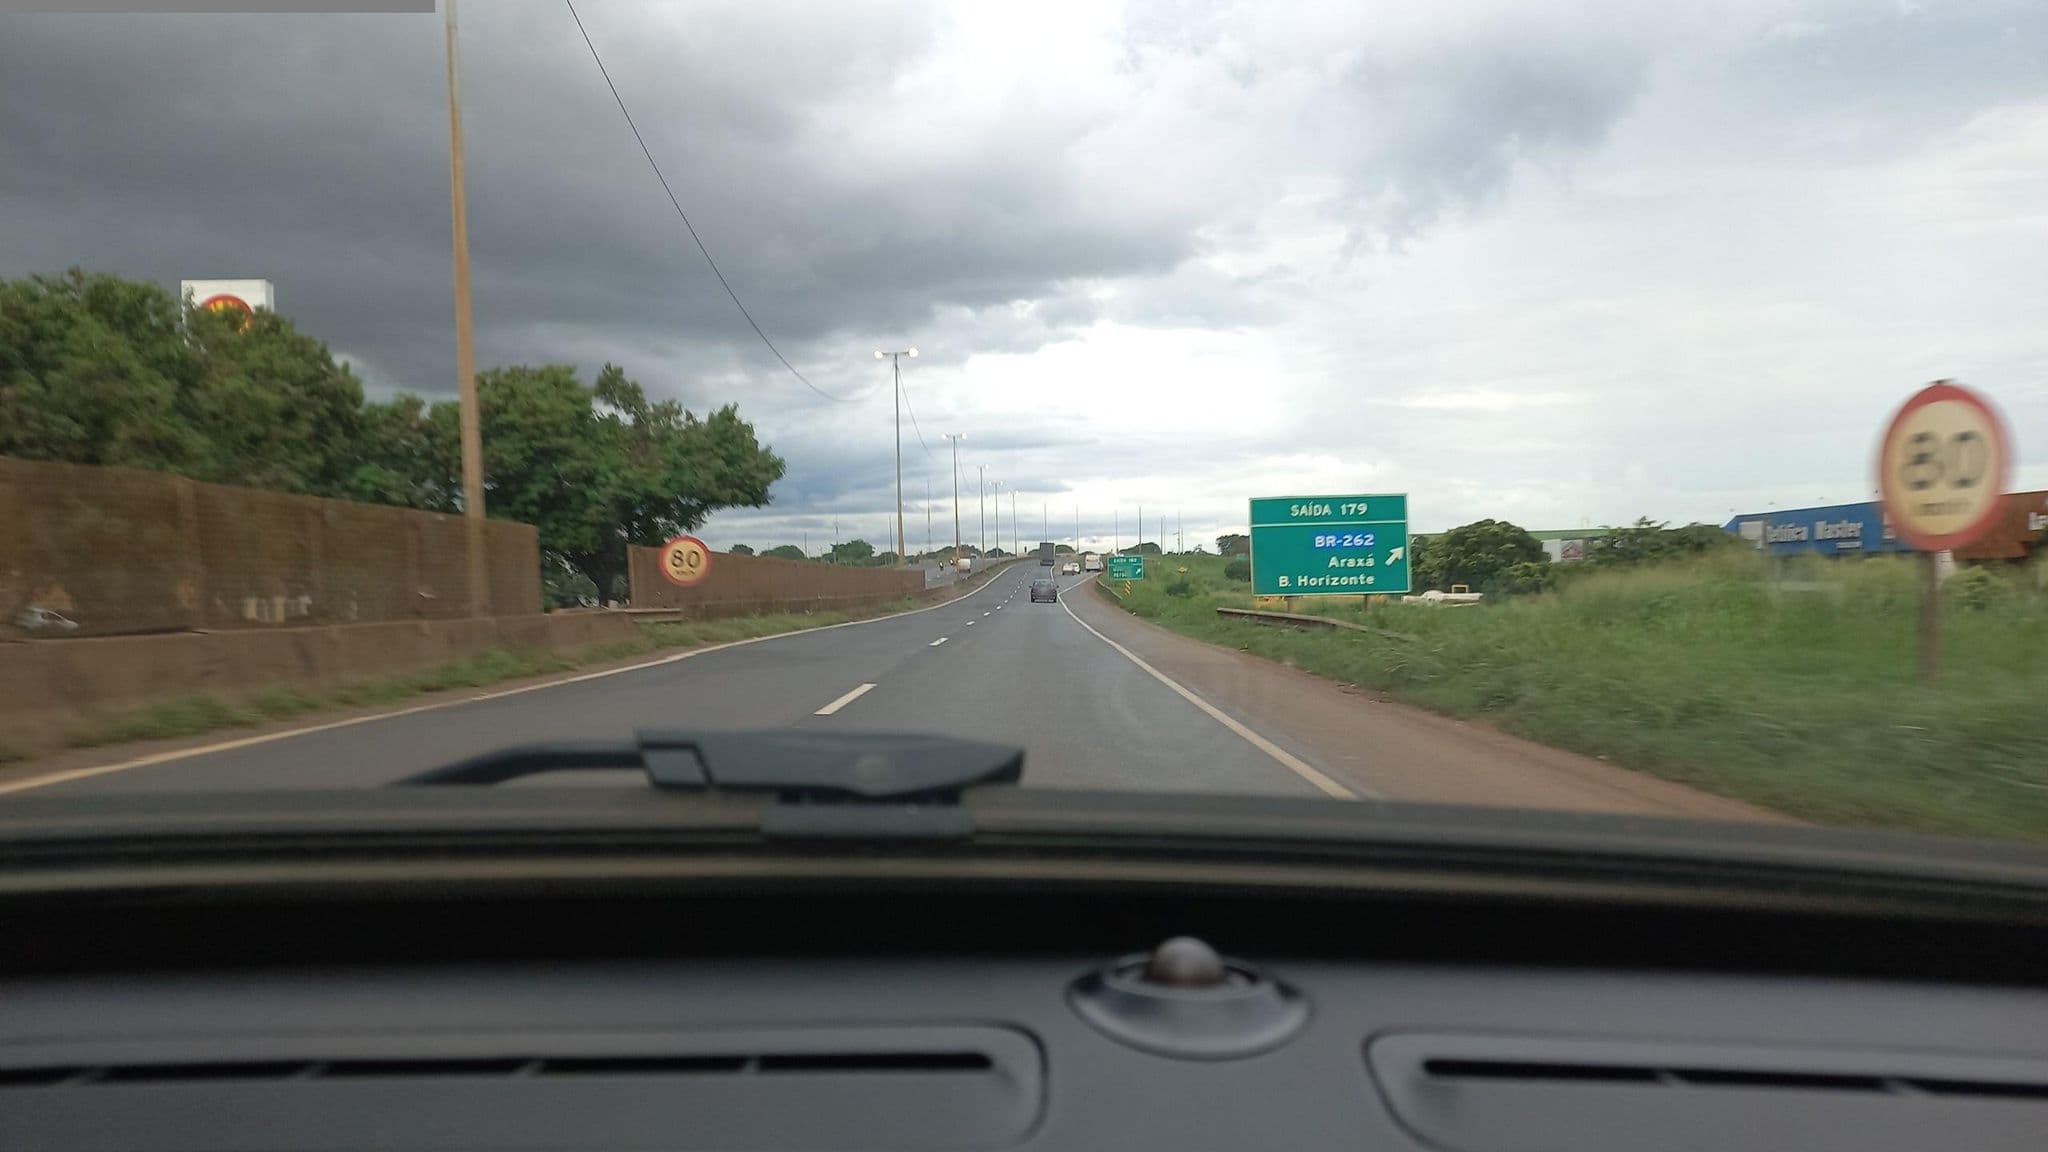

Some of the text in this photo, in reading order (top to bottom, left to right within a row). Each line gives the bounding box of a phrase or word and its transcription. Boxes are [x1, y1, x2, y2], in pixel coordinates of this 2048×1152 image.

[1899, 430, 1985, 491] 80
[1290, 501, 1368, 517] SAÍDA 179
[1814, 520, 1863, 540] Master
[1314, 534, 1375, 547] BR-262
[671, 549, 701, 568] 80
[1328, 553, 1375, 568] Araxá
[1278, 573, 1376, 587] B. Horizonte
